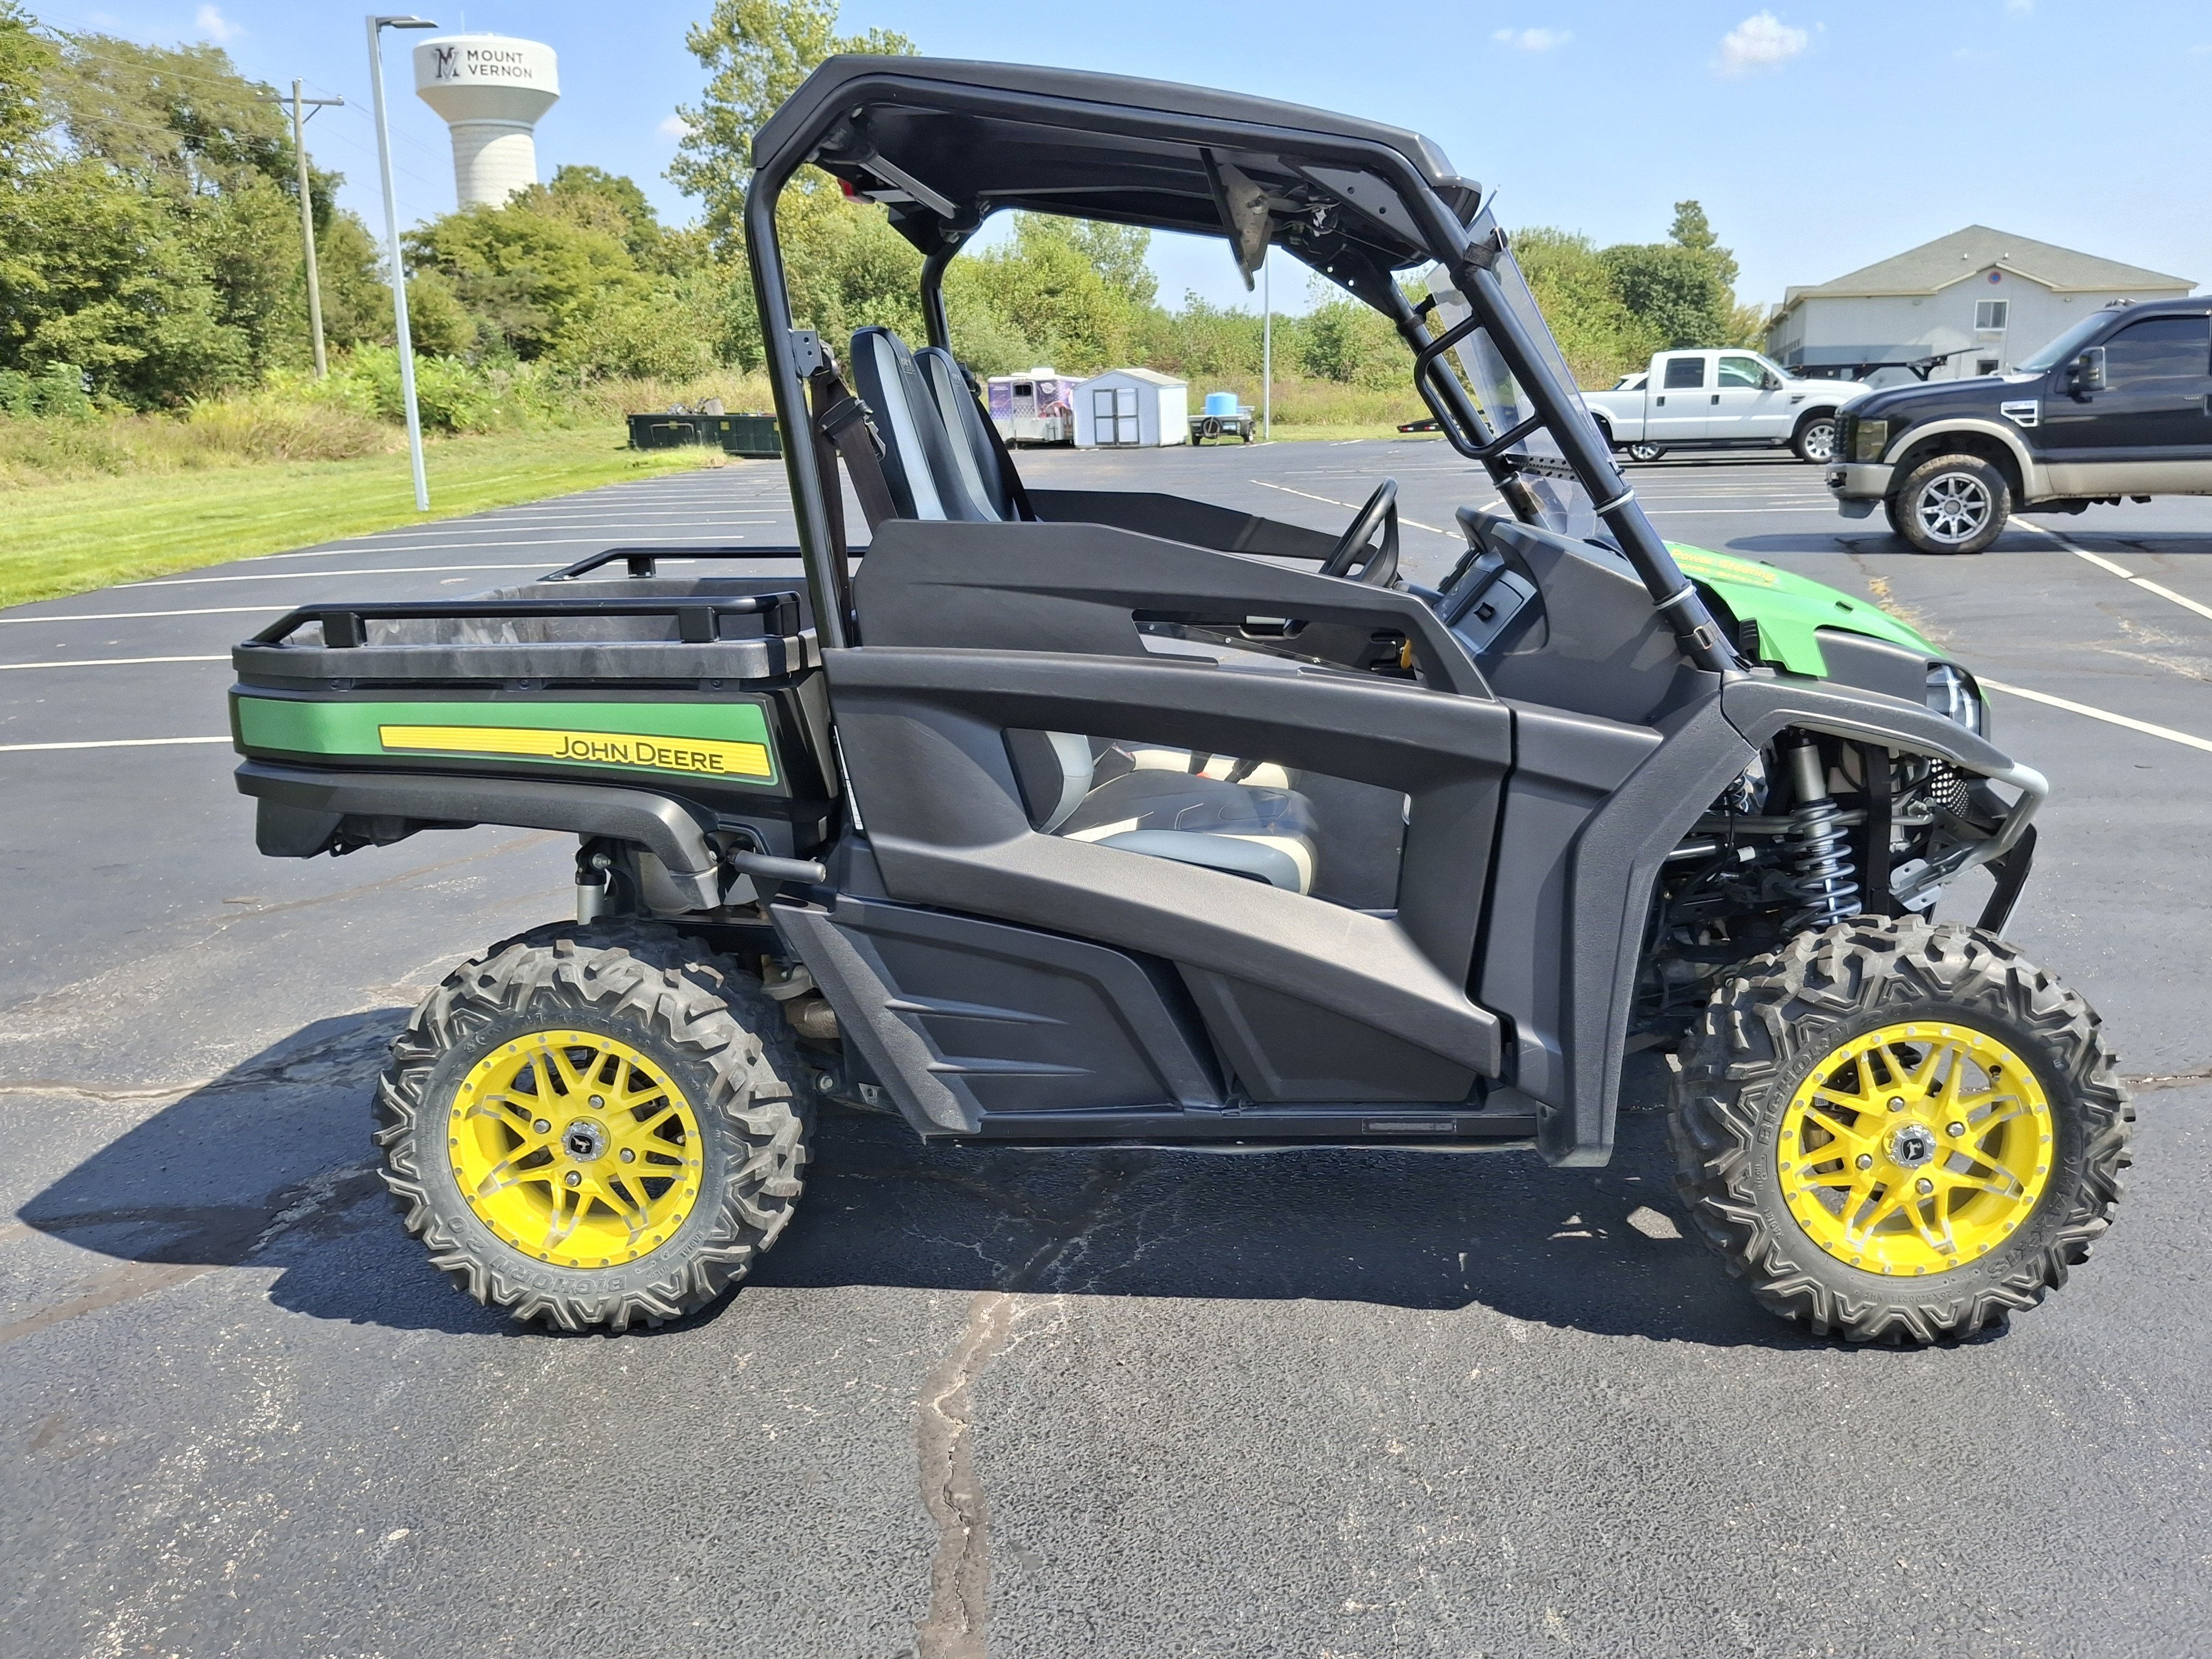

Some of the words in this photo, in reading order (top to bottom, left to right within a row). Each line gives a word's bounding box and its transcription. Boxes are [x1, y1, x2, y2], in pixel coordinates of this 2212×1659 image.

[467, 49, 524, 64] MOUNT
[468, 63, 533, 79] VERNON
[1670, 548, 1715, 565] Power
[1718, 558, 1777, 583] Steering
[679, 1230, 705, 1258] RADIAL
[489, 1255, 627, 1295] BIGHORN
